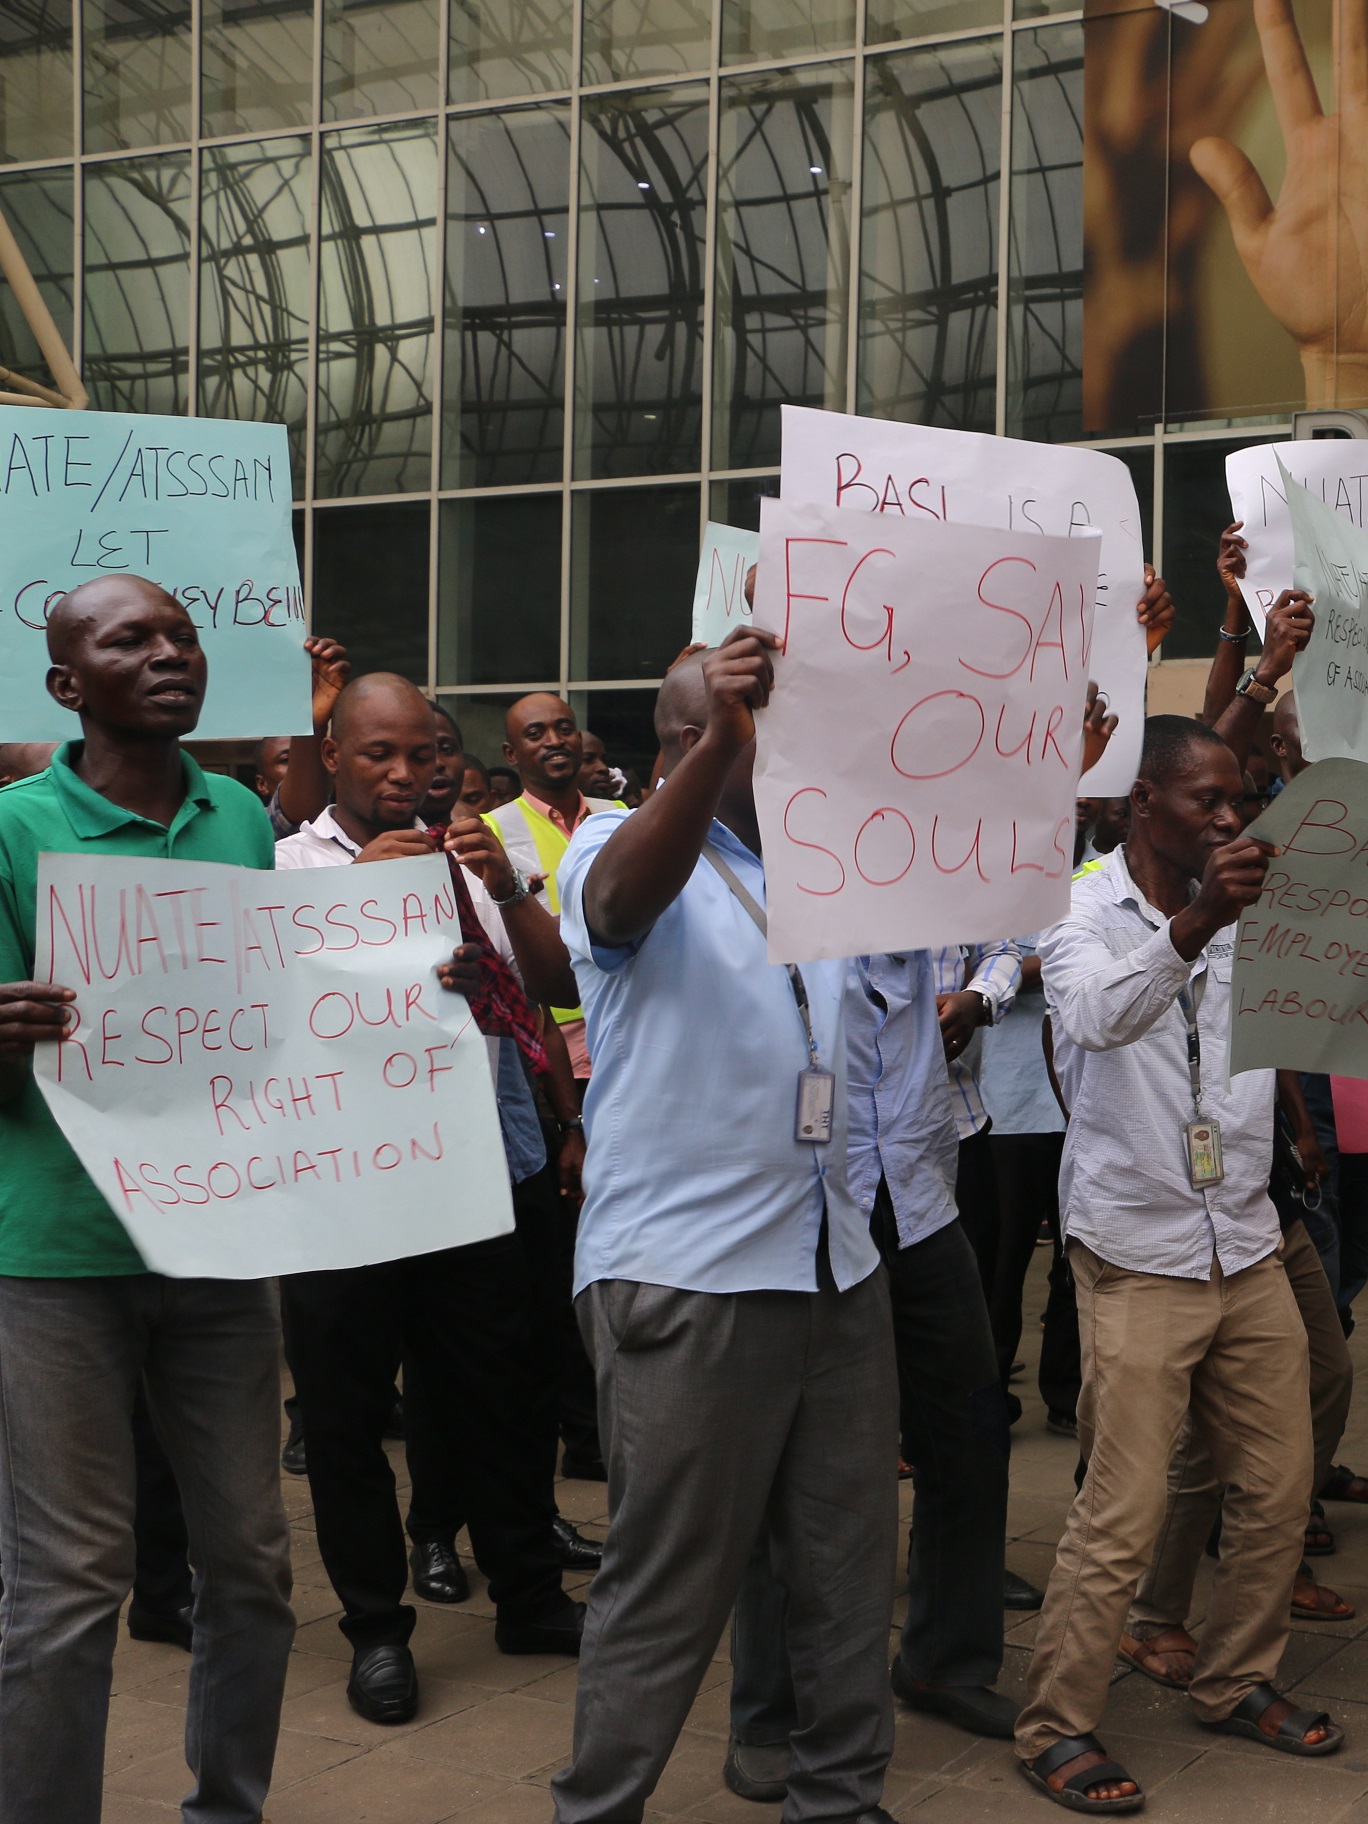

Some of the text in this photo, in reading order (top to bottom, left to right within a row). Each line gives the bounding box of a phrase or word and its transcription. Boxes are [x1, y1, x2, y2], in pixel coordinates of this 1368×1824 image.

[0, 429, 275, 513] ATE/ATSSSAN
[69, 528, 170, 569] LET
[782, 537, 914, 676] FG,
[888, 688, 1070, 783] OUR
[782, 786, 1072, 897] SOULS
[56, 981, 438, 1083] RESPECT OUR
[208, 1043, 457, 1137] RIGHT OF
[112, 1120, 446, 1216] ASSOCIATION
